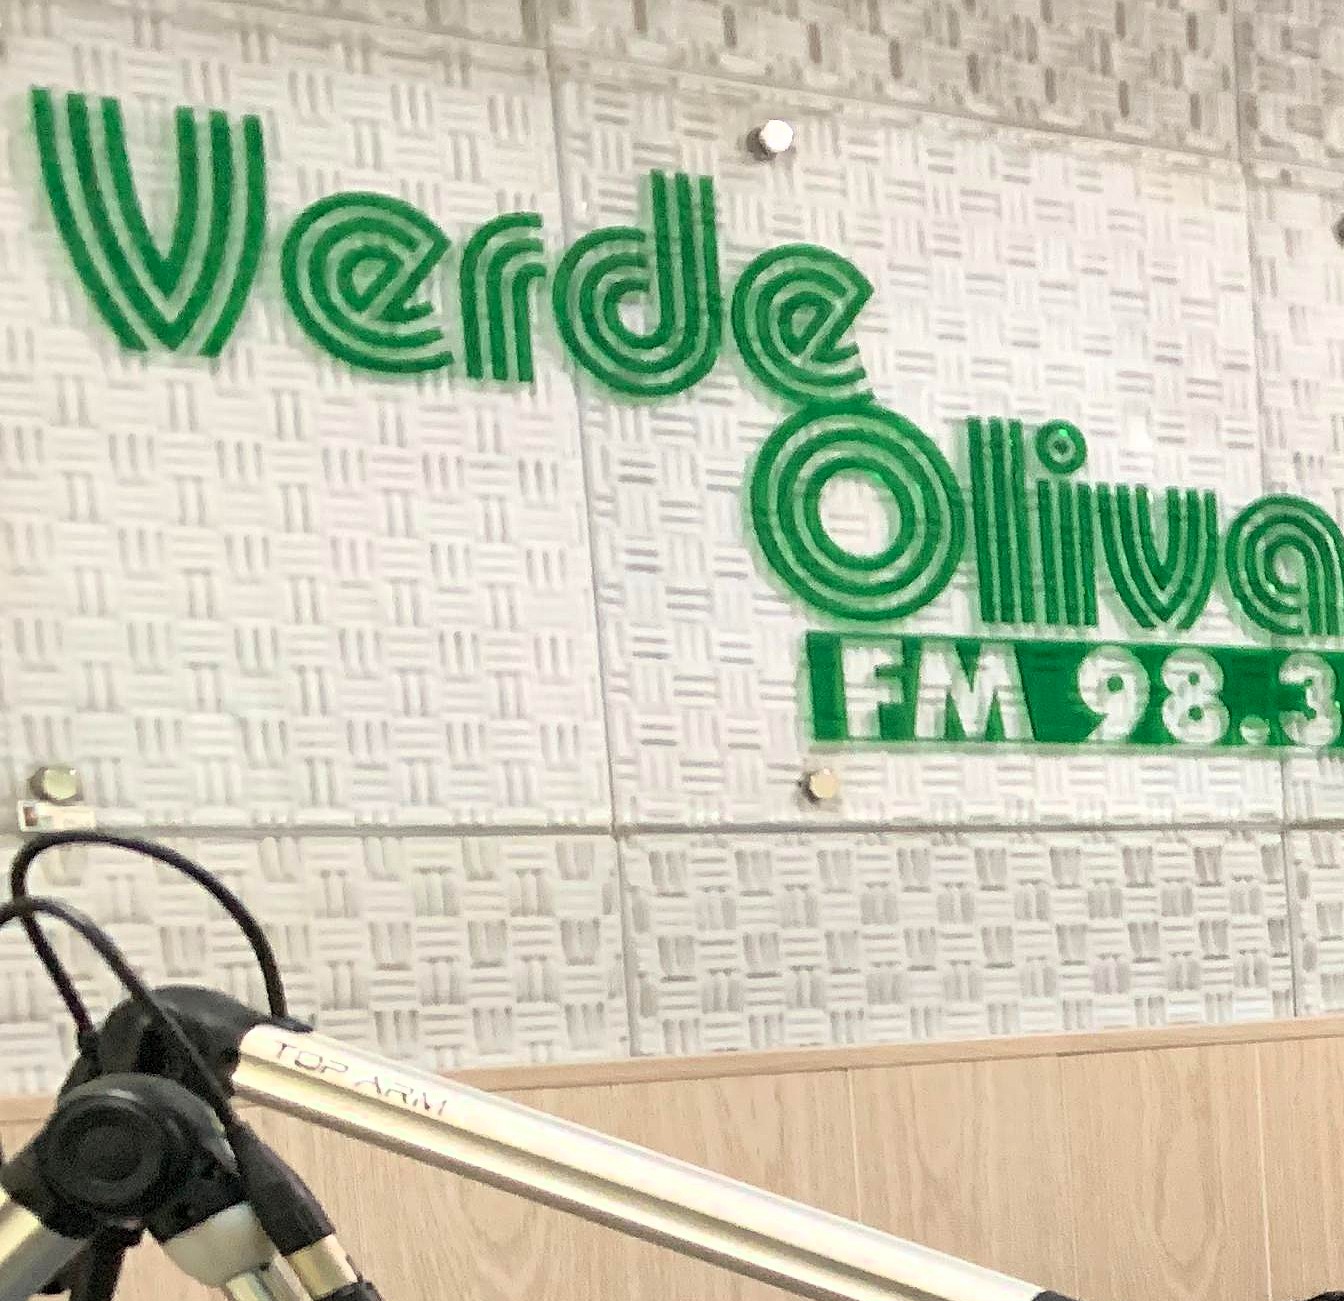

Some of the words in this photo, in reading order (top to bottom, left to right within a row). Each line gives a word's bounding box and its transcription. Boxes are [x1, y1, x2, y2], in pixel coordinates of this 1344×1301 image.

[30, 85, 874, 402] Verde
[842, 638, 1020, 741] FM
[1077, 647, 1344, 747] 98.3
[275, 1041, 349, 1073] TOP
[354, 1076, 448, 1116] ARM
